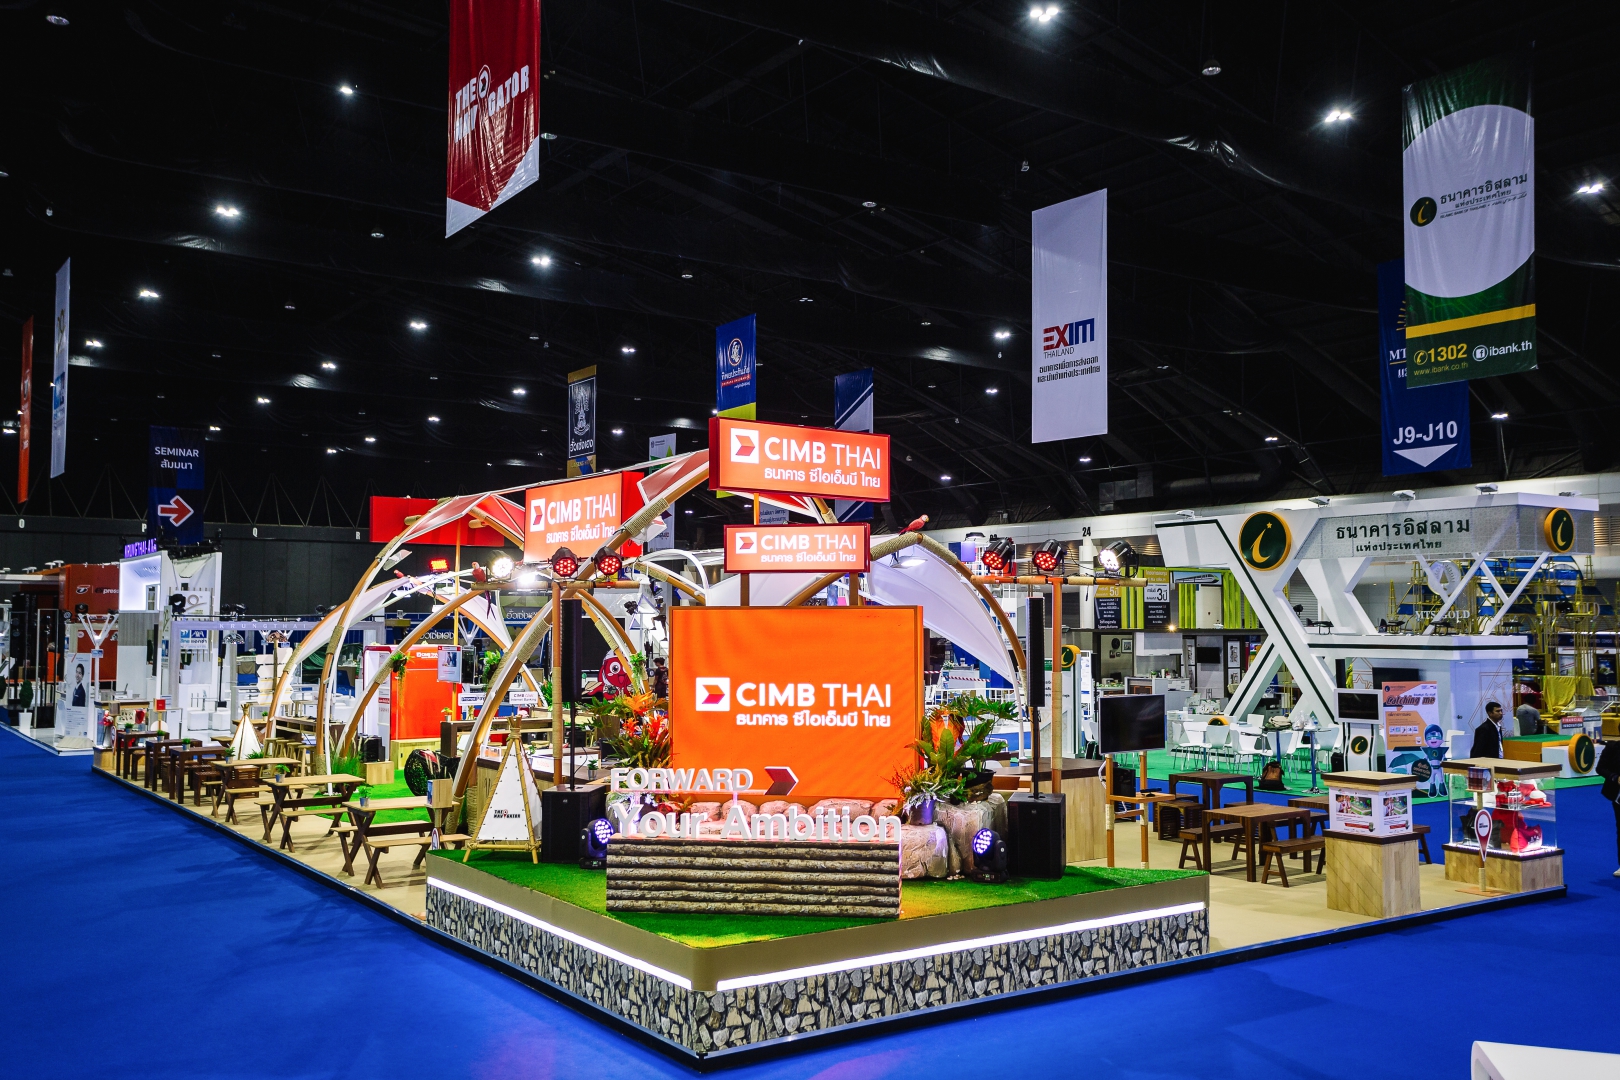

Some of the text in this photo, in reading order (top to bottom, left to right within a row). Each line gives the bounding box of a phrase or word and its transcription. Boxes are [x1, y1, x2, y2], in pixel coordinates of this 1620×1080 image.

[456, 77, 477, 115] THE
[1440, 173, 1528, 205] ธนาคารอิสลาม
[1455, 189, 1512, 209] แห่งประเทศไทย
[1043, 318, 1095, 351] EXIM
[1044, 346, 1075, 359] THAILAND
[1427, 343, 1468, 363] 1302
[1488, 340, 1533, 357] ibank.th
[1037, 365, 1101, 383] และนำเข้าแห่งประเทศไทย
[1039, 356, 1099, 374] ธนาคารเพื่อการส่งออก
[1413, 362, 1468, 376] www.ibank.co.th
[1393, 420, 1458, 445] J9-J10
[154, 446, 199, 458] SEMINAR
[764, 436, 881, 470] CIMB THAI
[160, 458, 193, 470] สัมมนา
[764, 467, 881, 488] ธนาคาร ซีไอเอ็มบี ไทย
[547, 492, 616, 525] CIMB THAI
[141, 522, 147, 533] P
[252, 527, 258, 538] Q
[355, 531, 361, 540] R
[546, 530, 569, 544] ธนาคาร
[570, 523, 600, 542] ซีไอเอ็มบี
[1082, 527, 1092, 537] 24
[1336, 517, 1470, 539] ธนาคารอิสลาม
[760, 534, 856, 550] CIMB THAI
[1356, 539, 1442, 552] แห่งประเทศไทย
[760, 551, 856, 563] ธนาคาร ซีไอเอ็มบี ไทย
[1442, 610, 1470, 619] OLD
[735, 682, 891, 708] CIMB THAI
[1386, 695, 1436, 706] Catching me
[735, 709, 891, 727] ธนาคาร ซีไอเอ็มบี ไทย
[610, 768, 753, 792] FORWARD
[612, 803, 901, 843] Your Ambition
